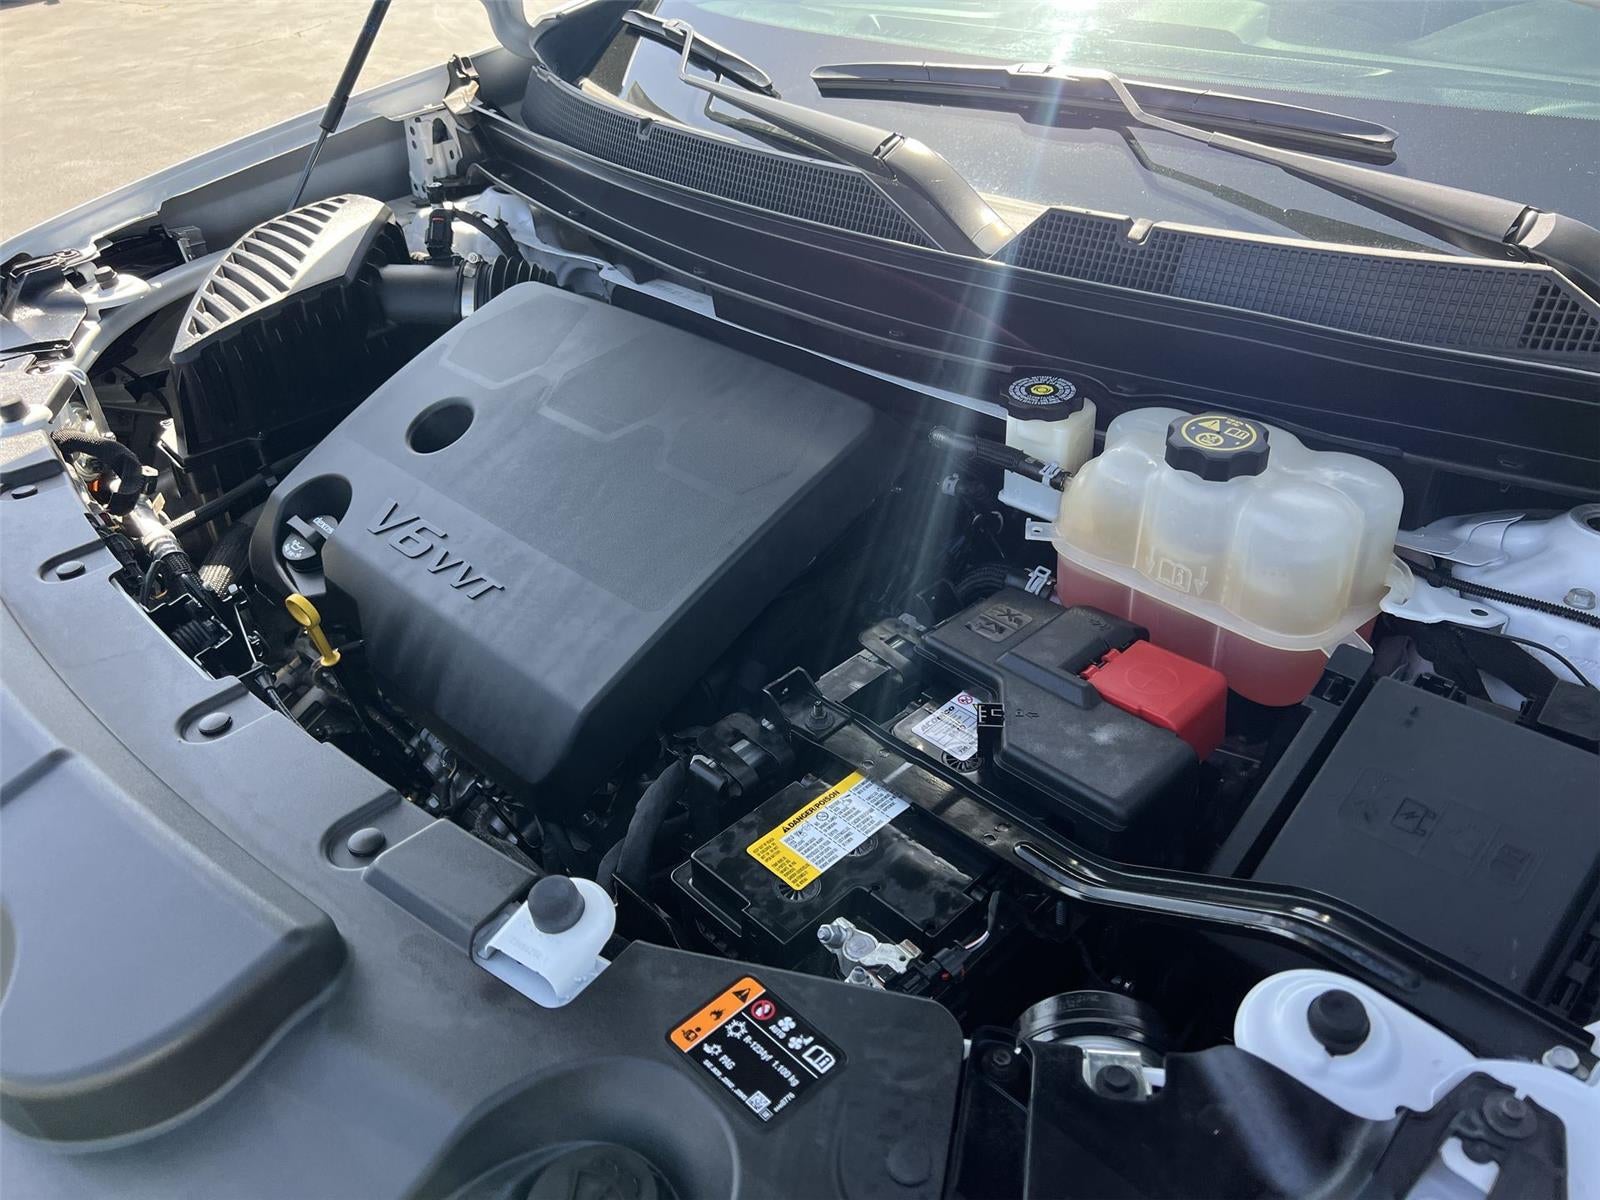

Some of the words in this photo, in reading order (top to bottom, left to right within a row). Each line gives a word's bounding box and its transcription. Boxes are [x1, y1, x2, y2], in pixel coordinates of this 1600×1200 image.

[313, 517, 335, 535] dexos
[787, 790, 841, 829] DANGER/POISON
[768, 1024, 787, 1039] AUTO
[718, 1054, 736, 1070] PAG
[772, 1060, 792, 1079] 1.100
[787, 1074, 800, 1087] kg
